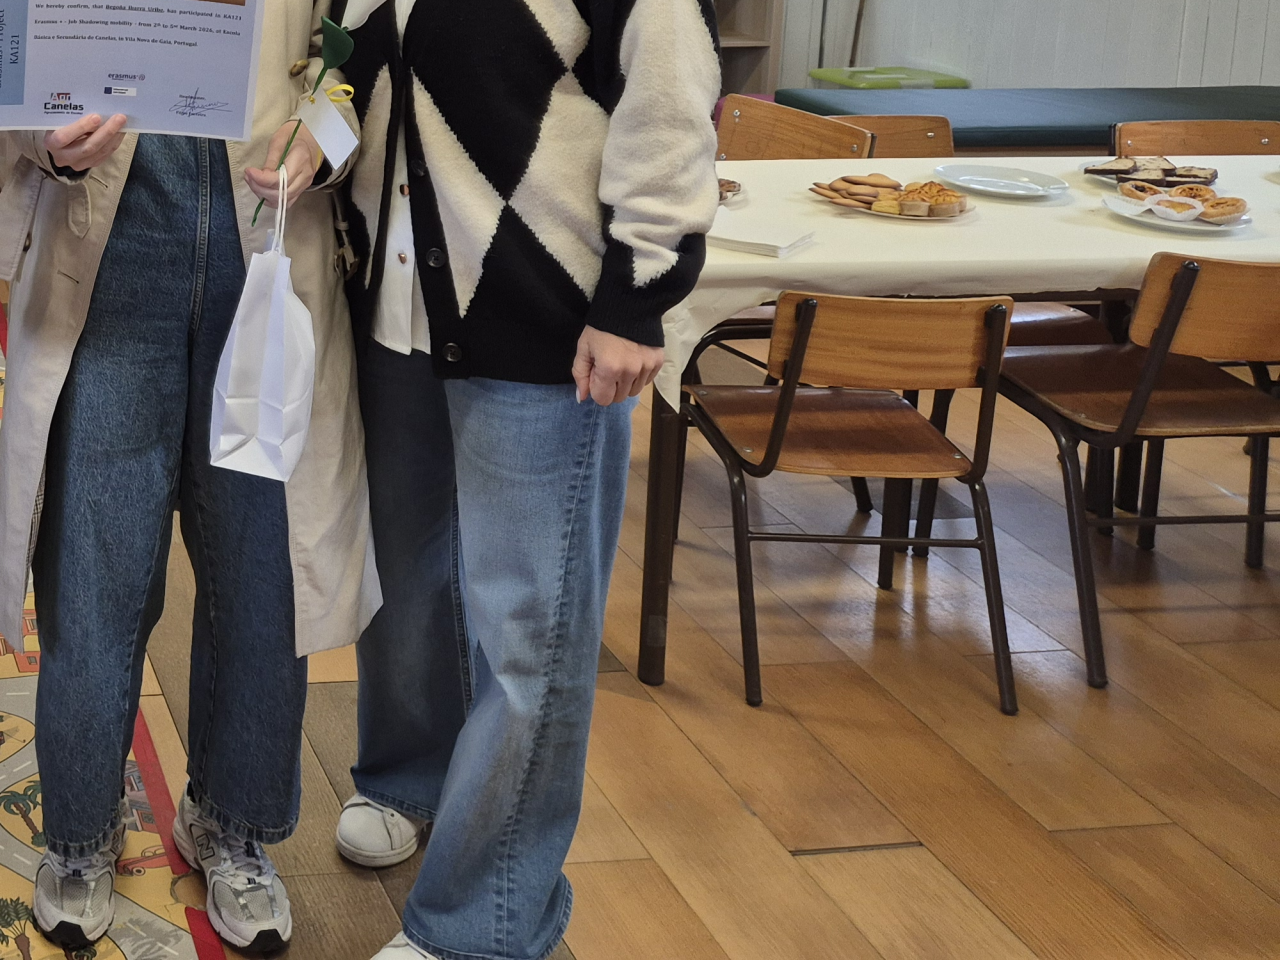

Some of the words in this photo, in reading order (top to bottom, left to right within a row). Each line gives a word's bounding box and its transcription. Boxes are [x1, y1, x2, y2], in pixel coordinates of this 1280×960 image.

[179, 9, 213, 17] participated
[10, 34, 19, 64] KA121
[44, 102, 84, 111] Canelas
[196, 834, 216, 860] N
